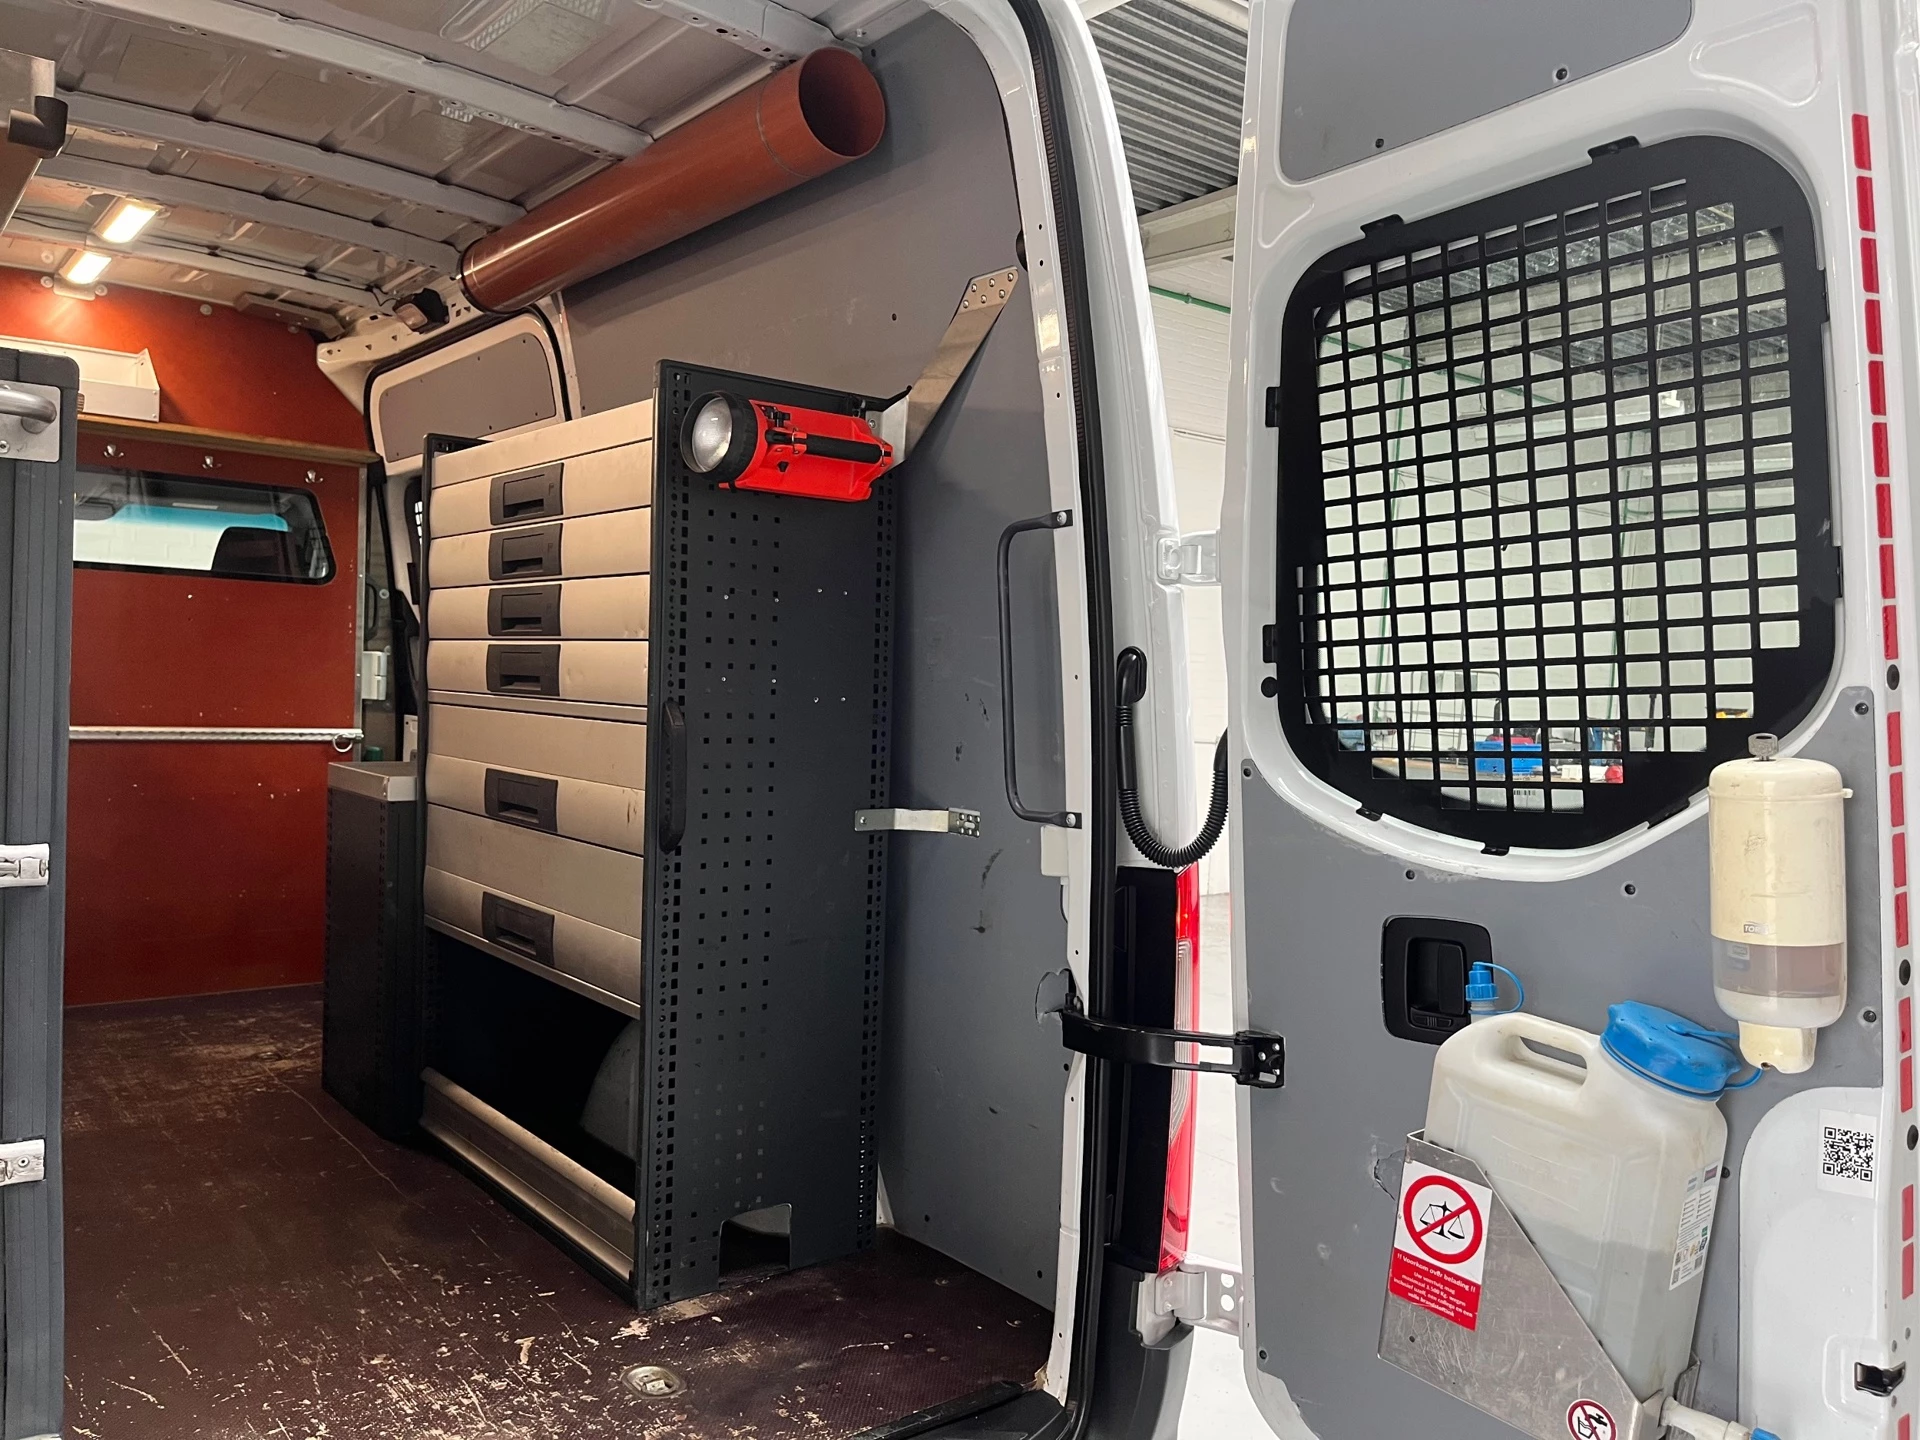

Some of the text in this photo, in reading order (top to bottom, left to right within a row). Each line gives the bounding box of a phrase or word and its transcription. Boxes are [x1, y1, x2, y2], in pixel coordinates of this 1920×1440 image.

[1744, 925, 1769, 935] TOR
[1403, 1256, 1428, 1272] Voorkom
[1430, 1269, 1442, 1277] over
[1444, 1274, 1469, 1291] belading
[1402, 1275, 1425, 1288] maximaal
[1449, 1296, 1466, 1306] wegen
[1408, 1292, 1419, 1300] volle
[1444, 1286, 1455, 1295] mag
[1438, 1298, 1455, 1309] collega
[1463, 1309, 1473, 1317] een
